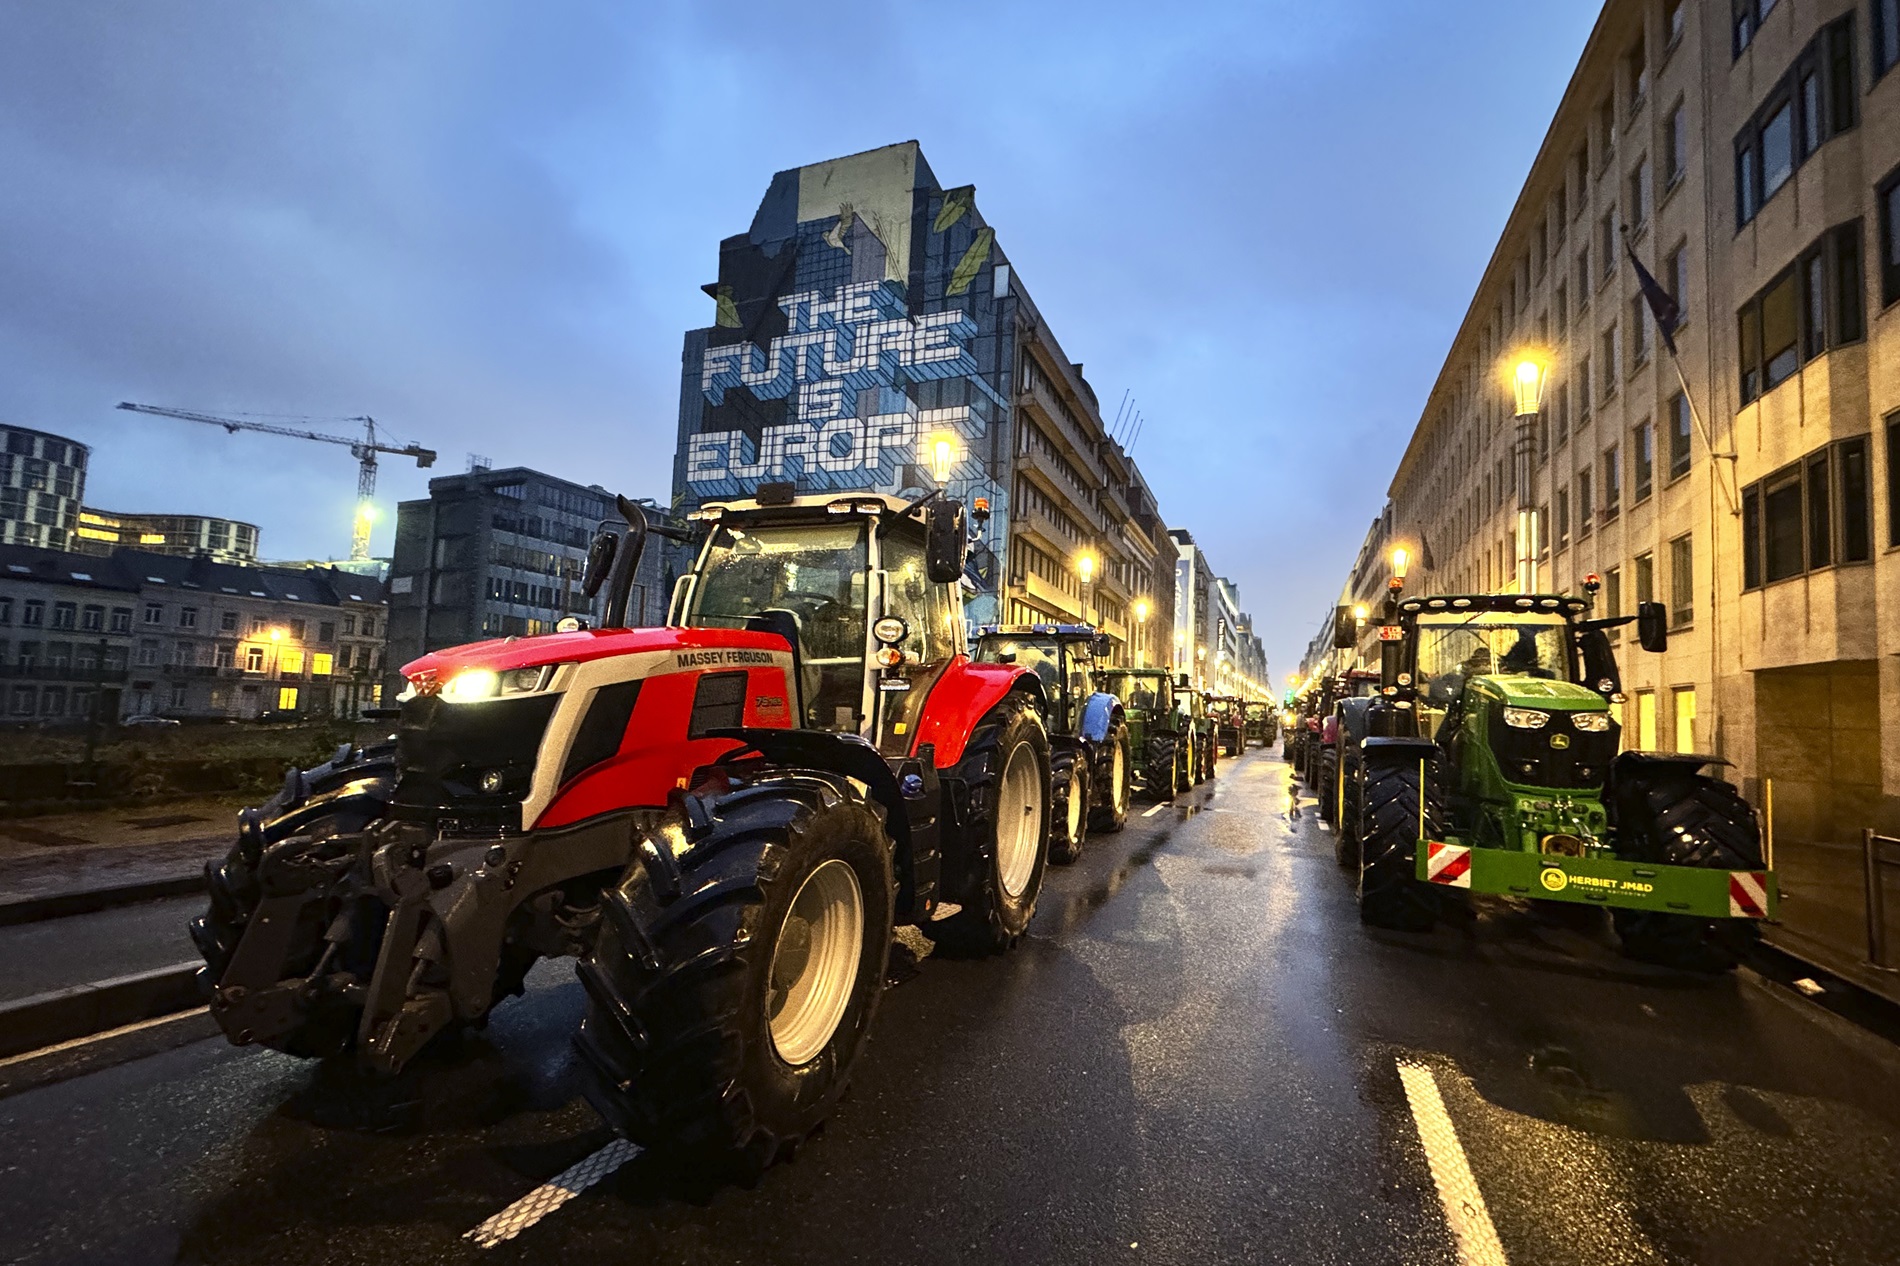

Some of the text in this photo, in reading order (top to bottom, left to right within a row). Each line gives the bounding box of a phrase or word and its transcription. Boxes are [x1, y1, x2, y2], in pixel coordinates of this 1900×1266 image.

[778, 280, 880, 332] THE
[702, 309, 963, 392] FUTURE
[798, 378, 844, 420] IS
[687, 405, 970, 482] EUROPE
[677, 651, 773, 667] MASSEY FERGUSON
[1568, 875, 1653, 892] HERBIET JM&D
